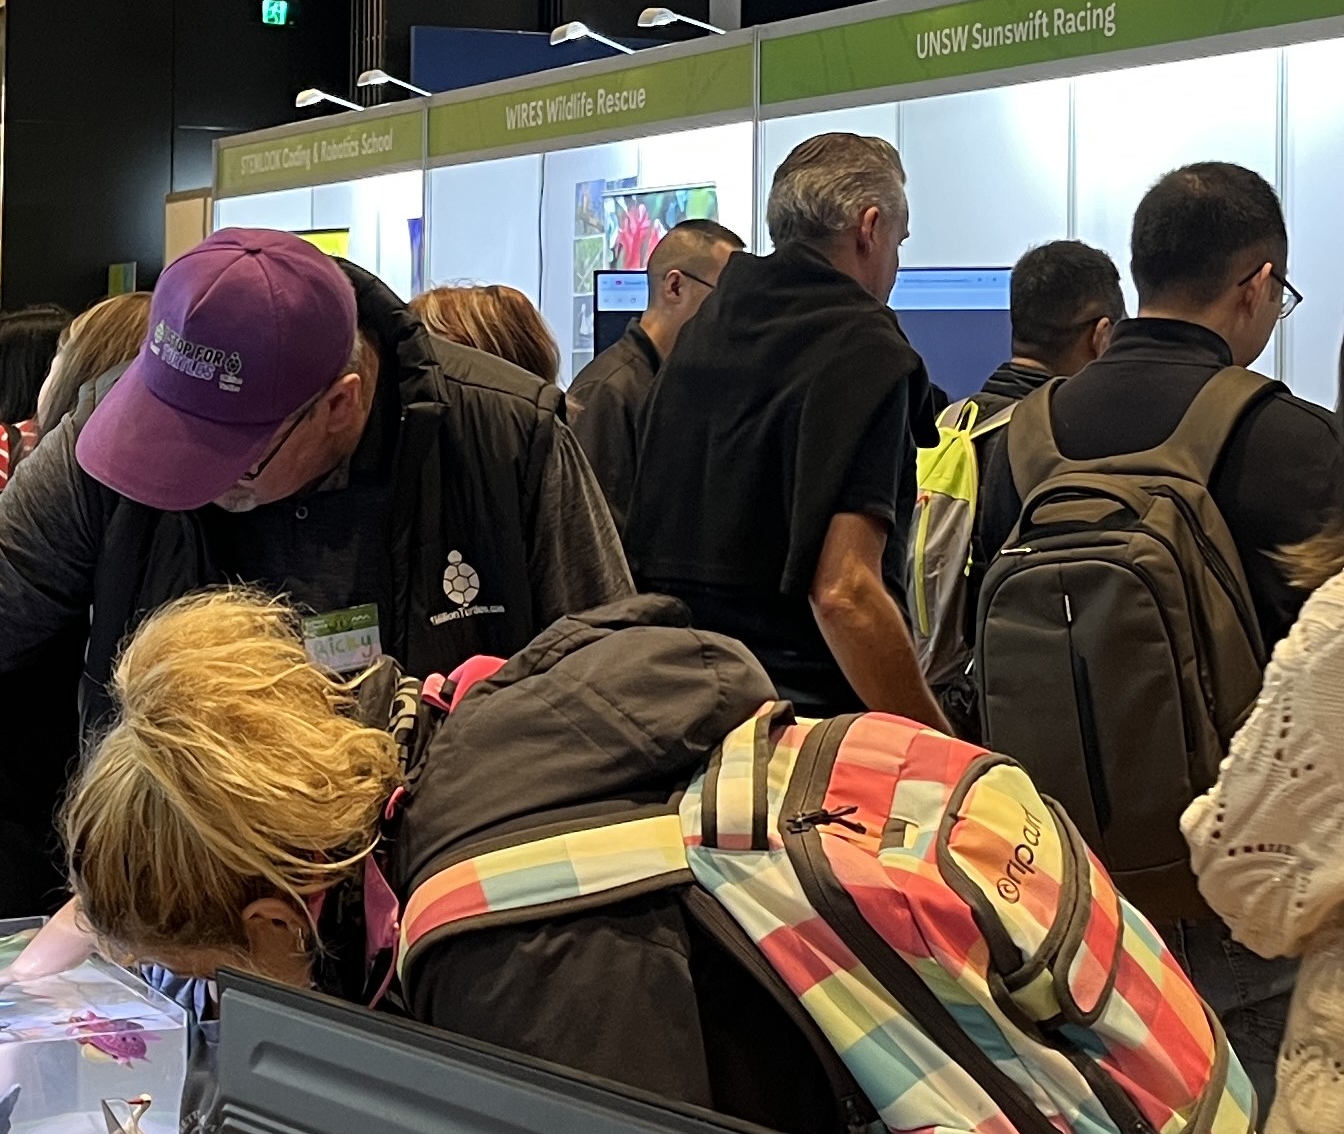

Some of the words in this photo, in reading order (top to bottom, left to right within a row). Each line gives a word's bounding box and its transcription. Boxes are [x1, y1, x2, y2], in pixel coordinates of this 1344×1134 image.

[916, 25, 969, 59] UNSW
[972, 9, 1049, 50] Sunswift
[1054, 2, 1116, 37] Racing
[505, 100, 543, 130] WIRES
[546, 91, 593, 123] Wildlife
[597, 87, 646, 115] Rescue
[282, 142, 311, 170] Coding
[321, 136, 359, 162] Robotics
[361, 128, 393, 155] School
[194, 346, 224, 366] FOR
